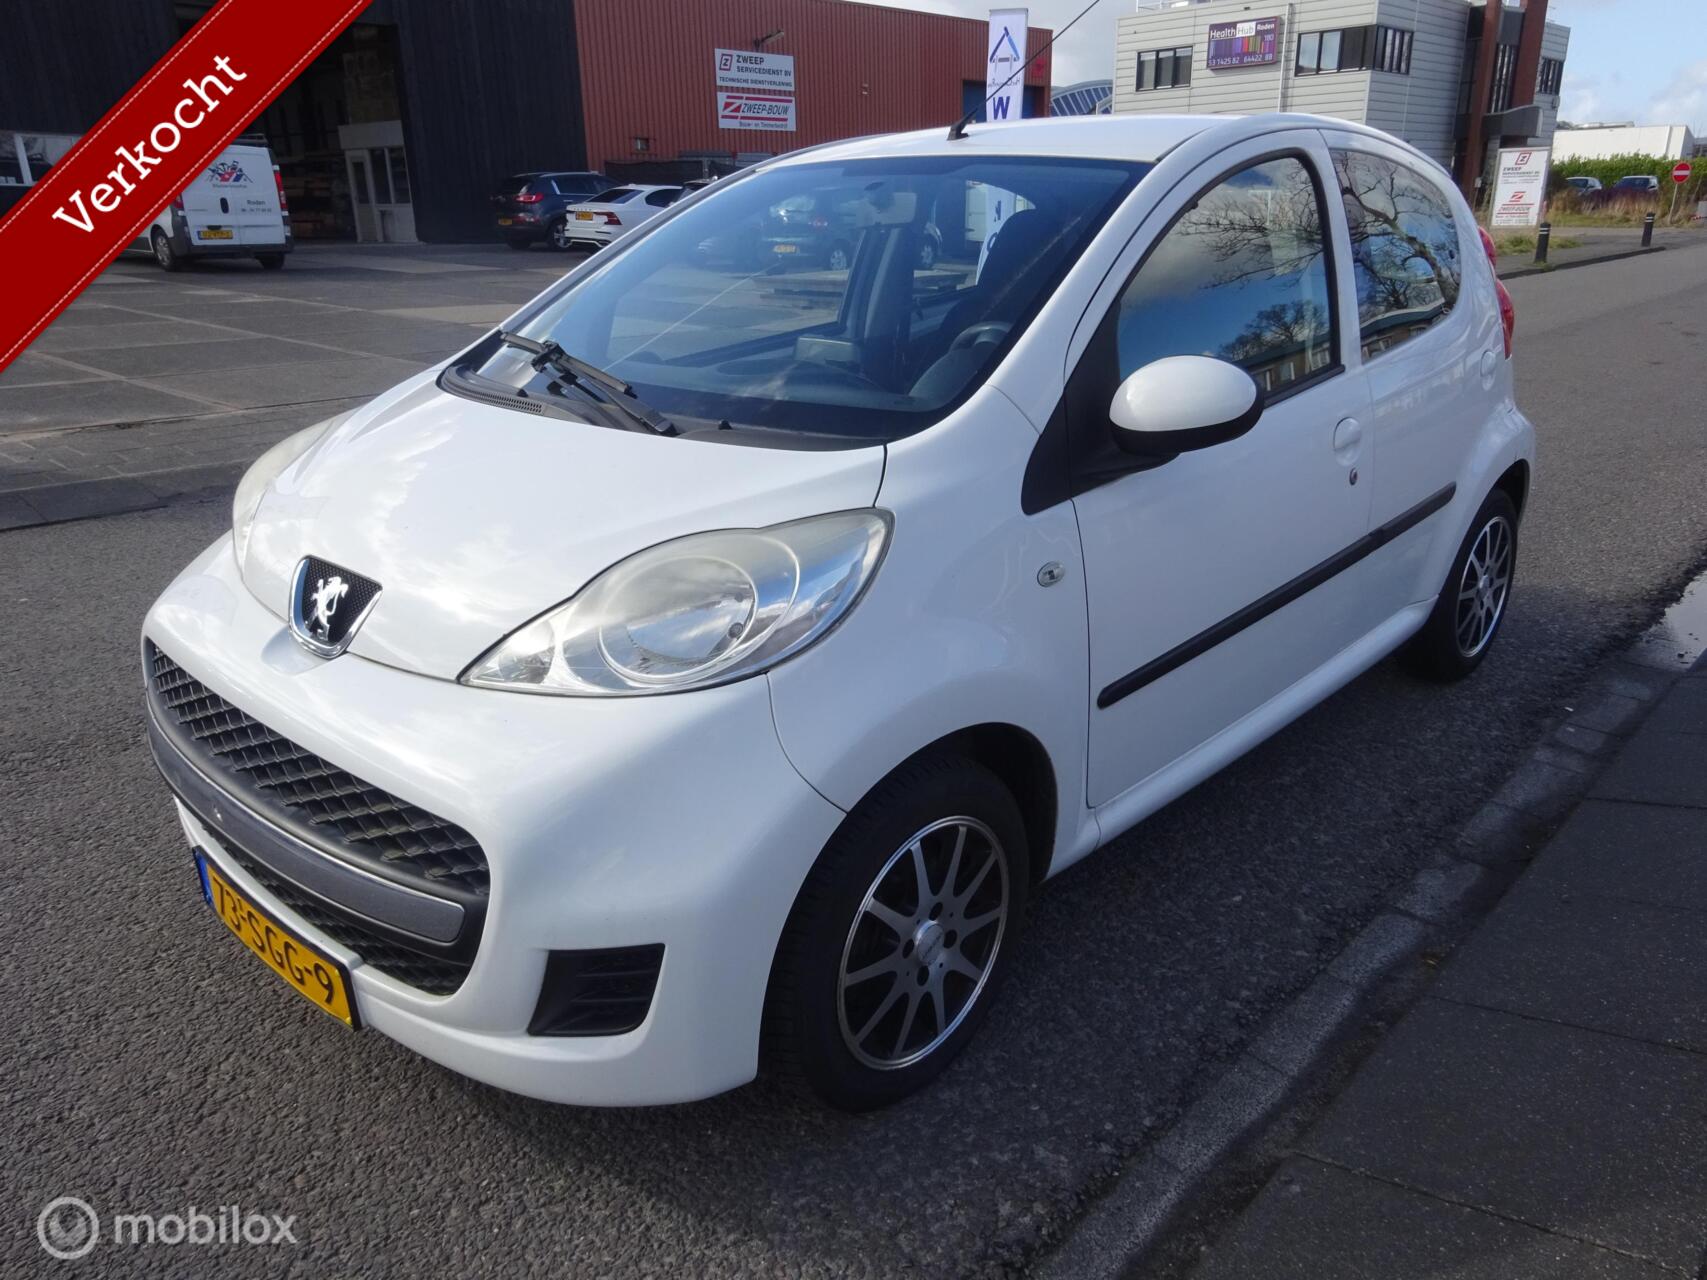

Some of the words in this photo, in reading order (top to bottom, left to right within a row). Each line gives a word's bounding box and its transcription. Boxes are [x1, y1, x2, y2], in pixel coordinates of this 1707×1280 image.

[1210, 27, 1236, 38] Health
[1237, 25, 1254, 35] Hub
[736, 54, 765, 65] ZWEEP
[736, 66, 783, 76] SERVICEDIENST
[741, 103, 790, 115] ZWEEP-BOUW
[212, 876, 335, 1005] 73-SGG-9
